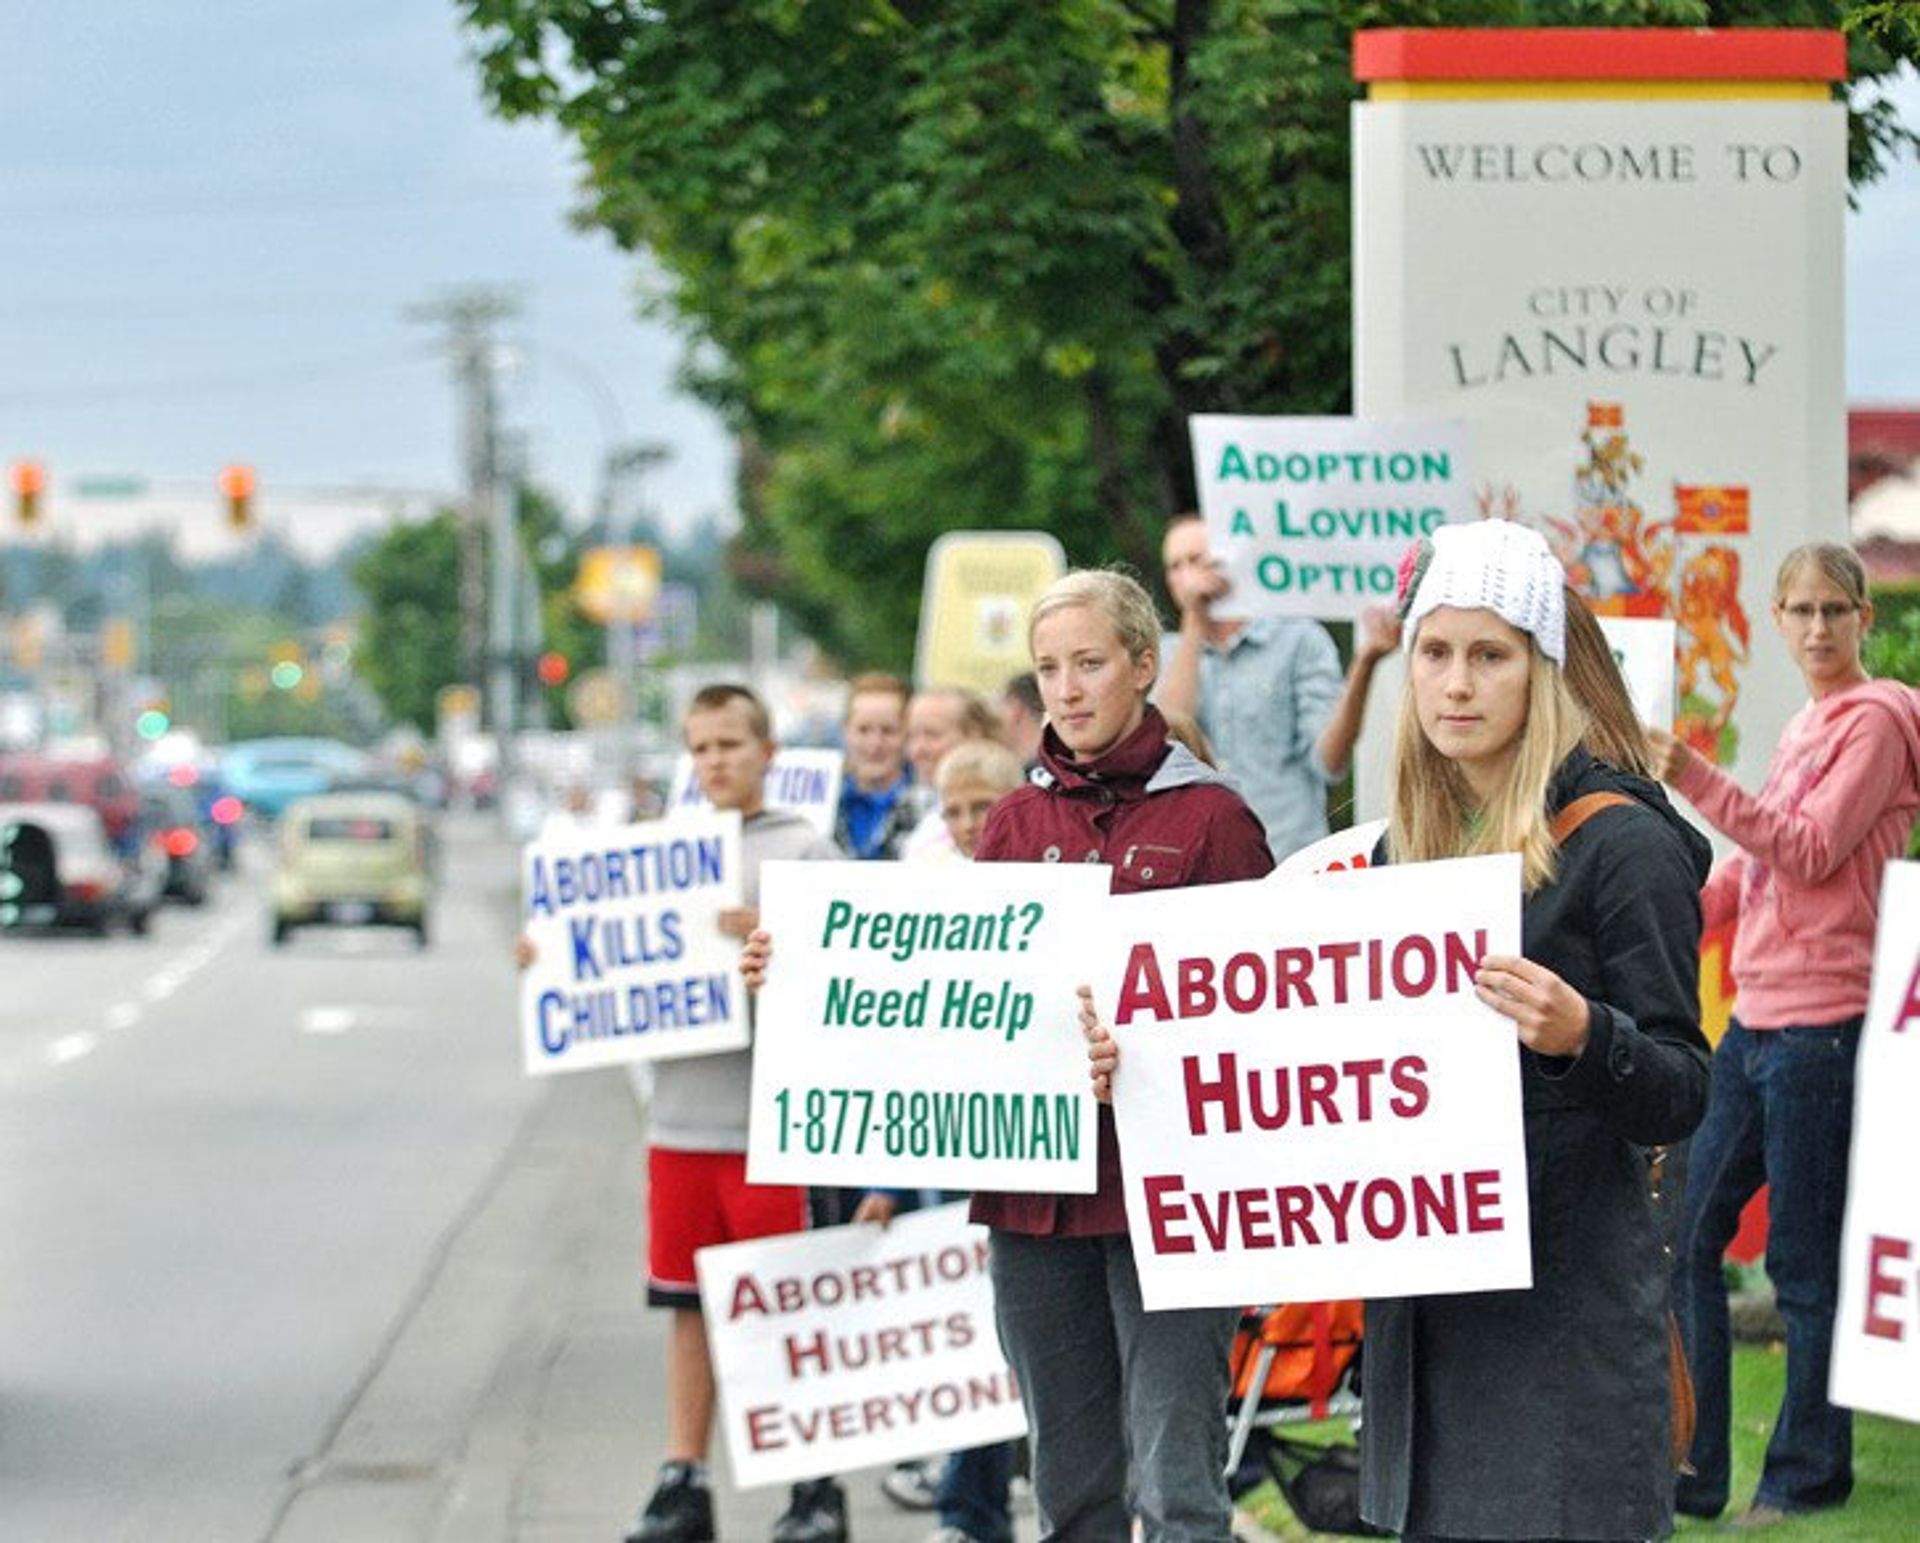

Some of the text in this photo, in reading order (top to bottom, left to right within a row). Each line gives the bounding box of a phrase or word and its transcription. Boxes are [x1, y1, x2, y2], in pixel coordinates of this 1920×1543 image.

[1418, 144, 1803, 182] WELCOME TO
[1529, 287, 1698, 316] CITY OF
[1449, 324, 1777, 388] LANGLEY
[1217, 442, 1451, 482] ADOPTION
[1231, 499, 1444, 539] A LOVING
[1256, 553, 1396, 593] OPTIO
[527, 836, 724, 916] ABORTION
[568, 910, 683, 981] KILLS
[822, 901, 1043, 962] Pregnant?
[824, 977, 1034, 1041] Need Help
[1115, 929, 1488, 1025] ABORTION
[537, 972, 730, 1057] CHILDREN
[775, 1088, 1081, 1161] 1-877-88WOMAN
[1182, 1052, 1430, 1136] HURTS
[1143, 1170, 1505, 1255] EVERYONE
[785, 1311, 976, 1379] HURTS
